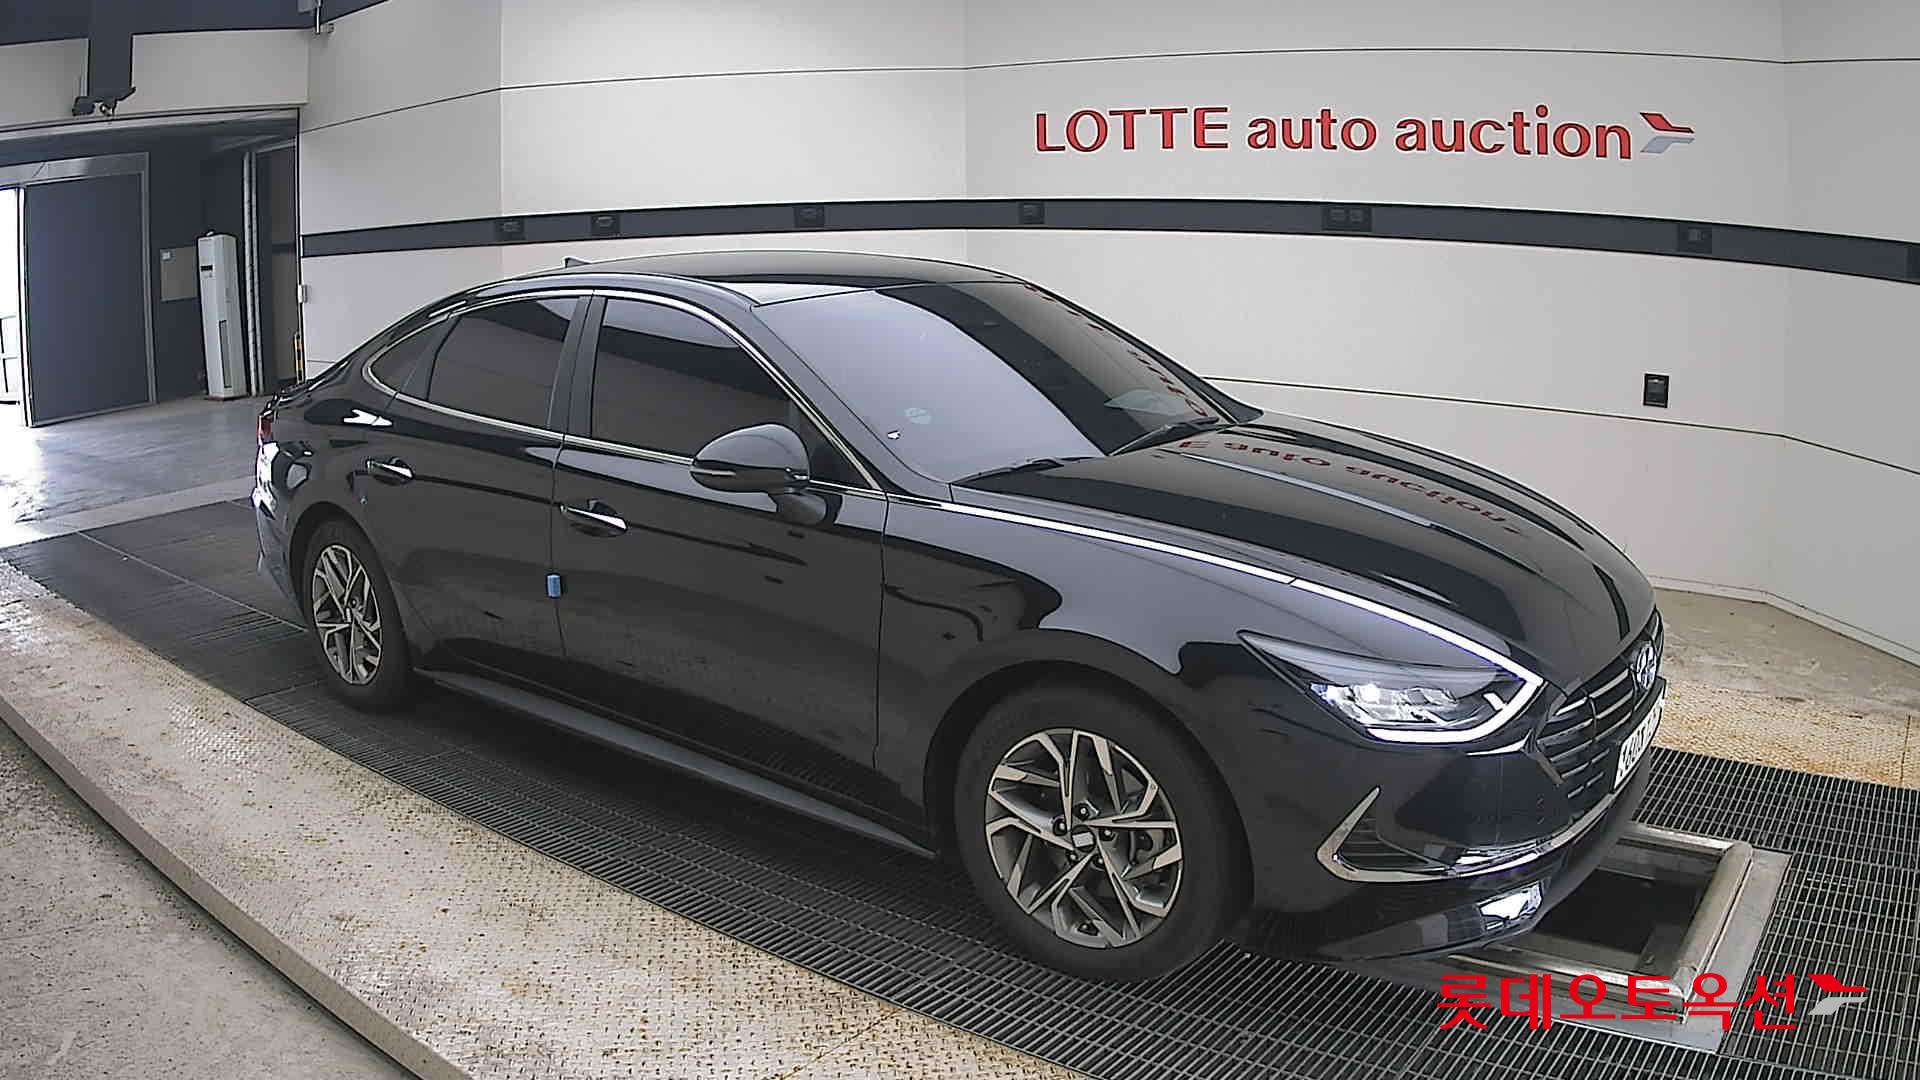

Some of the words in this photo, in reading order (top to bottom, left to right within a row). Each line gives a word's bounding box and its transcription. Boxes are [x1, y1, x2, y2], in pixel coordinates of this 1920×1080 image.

[1035, 106, 1229, 153] LOTTE
[1246, 108, 1378, 152] auto
[1395, 104, 1632, 160] auction
